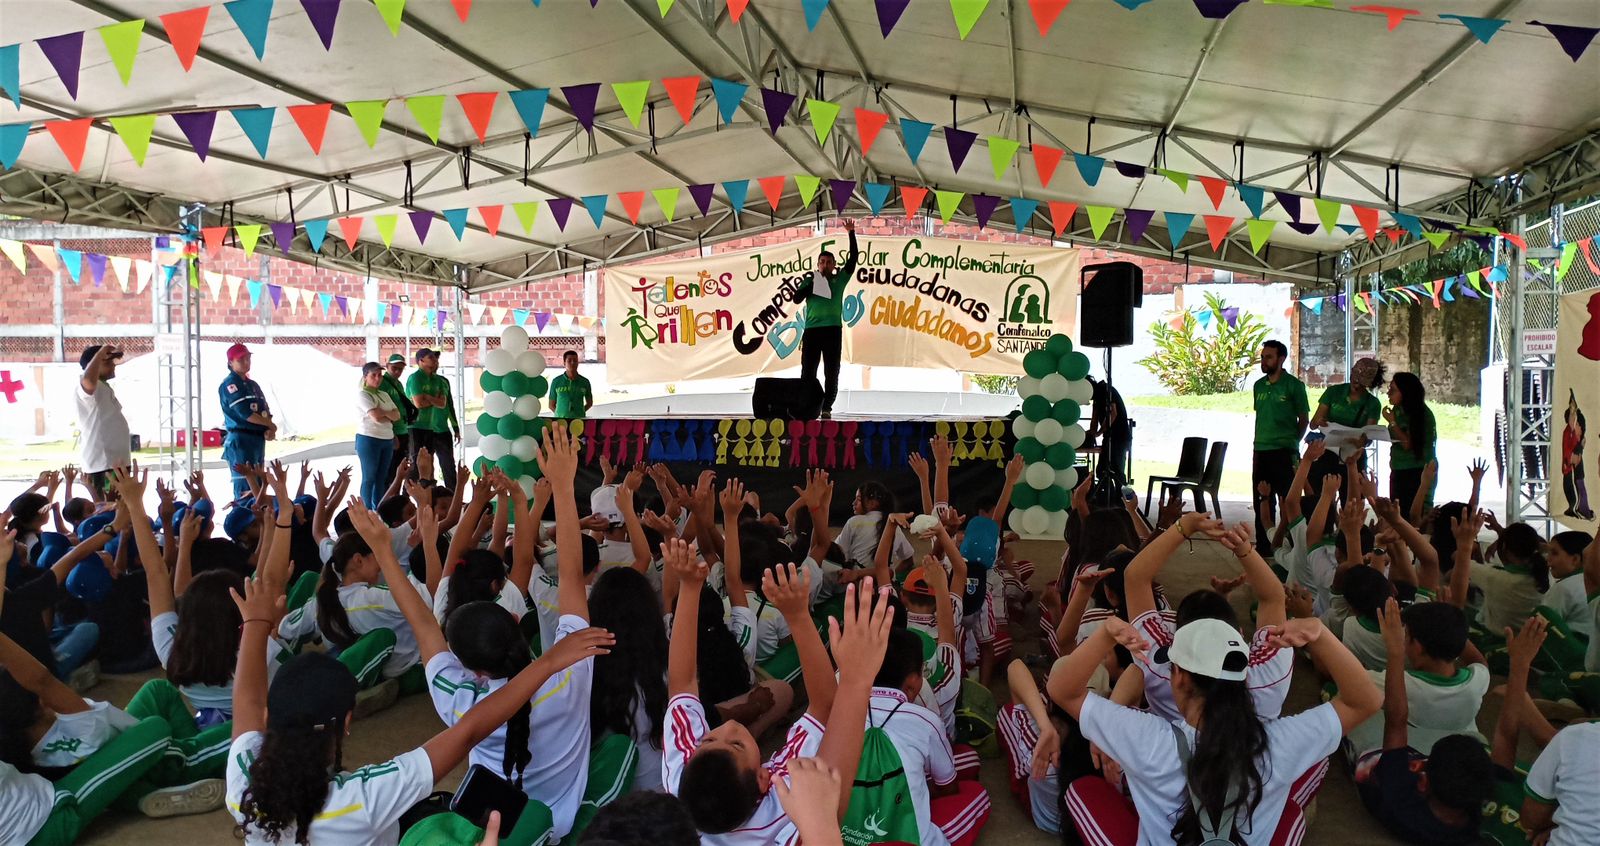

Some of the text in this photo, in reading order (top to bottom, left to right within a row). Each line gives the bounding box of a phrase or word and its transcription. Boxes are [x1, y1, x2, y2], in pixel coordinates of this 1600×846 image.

[747, 249, 812, 282] Jornada
[902, 238, 1035, 279] Complementaria
[631, 270, 732, 318] Talentos
[654, 304, 680, 318] Que
[620, 304, 732, 349] Brillan
[997, 323, 1051, 337] Comfenalco
[997, 339, 1046, 353] SANTANDE
